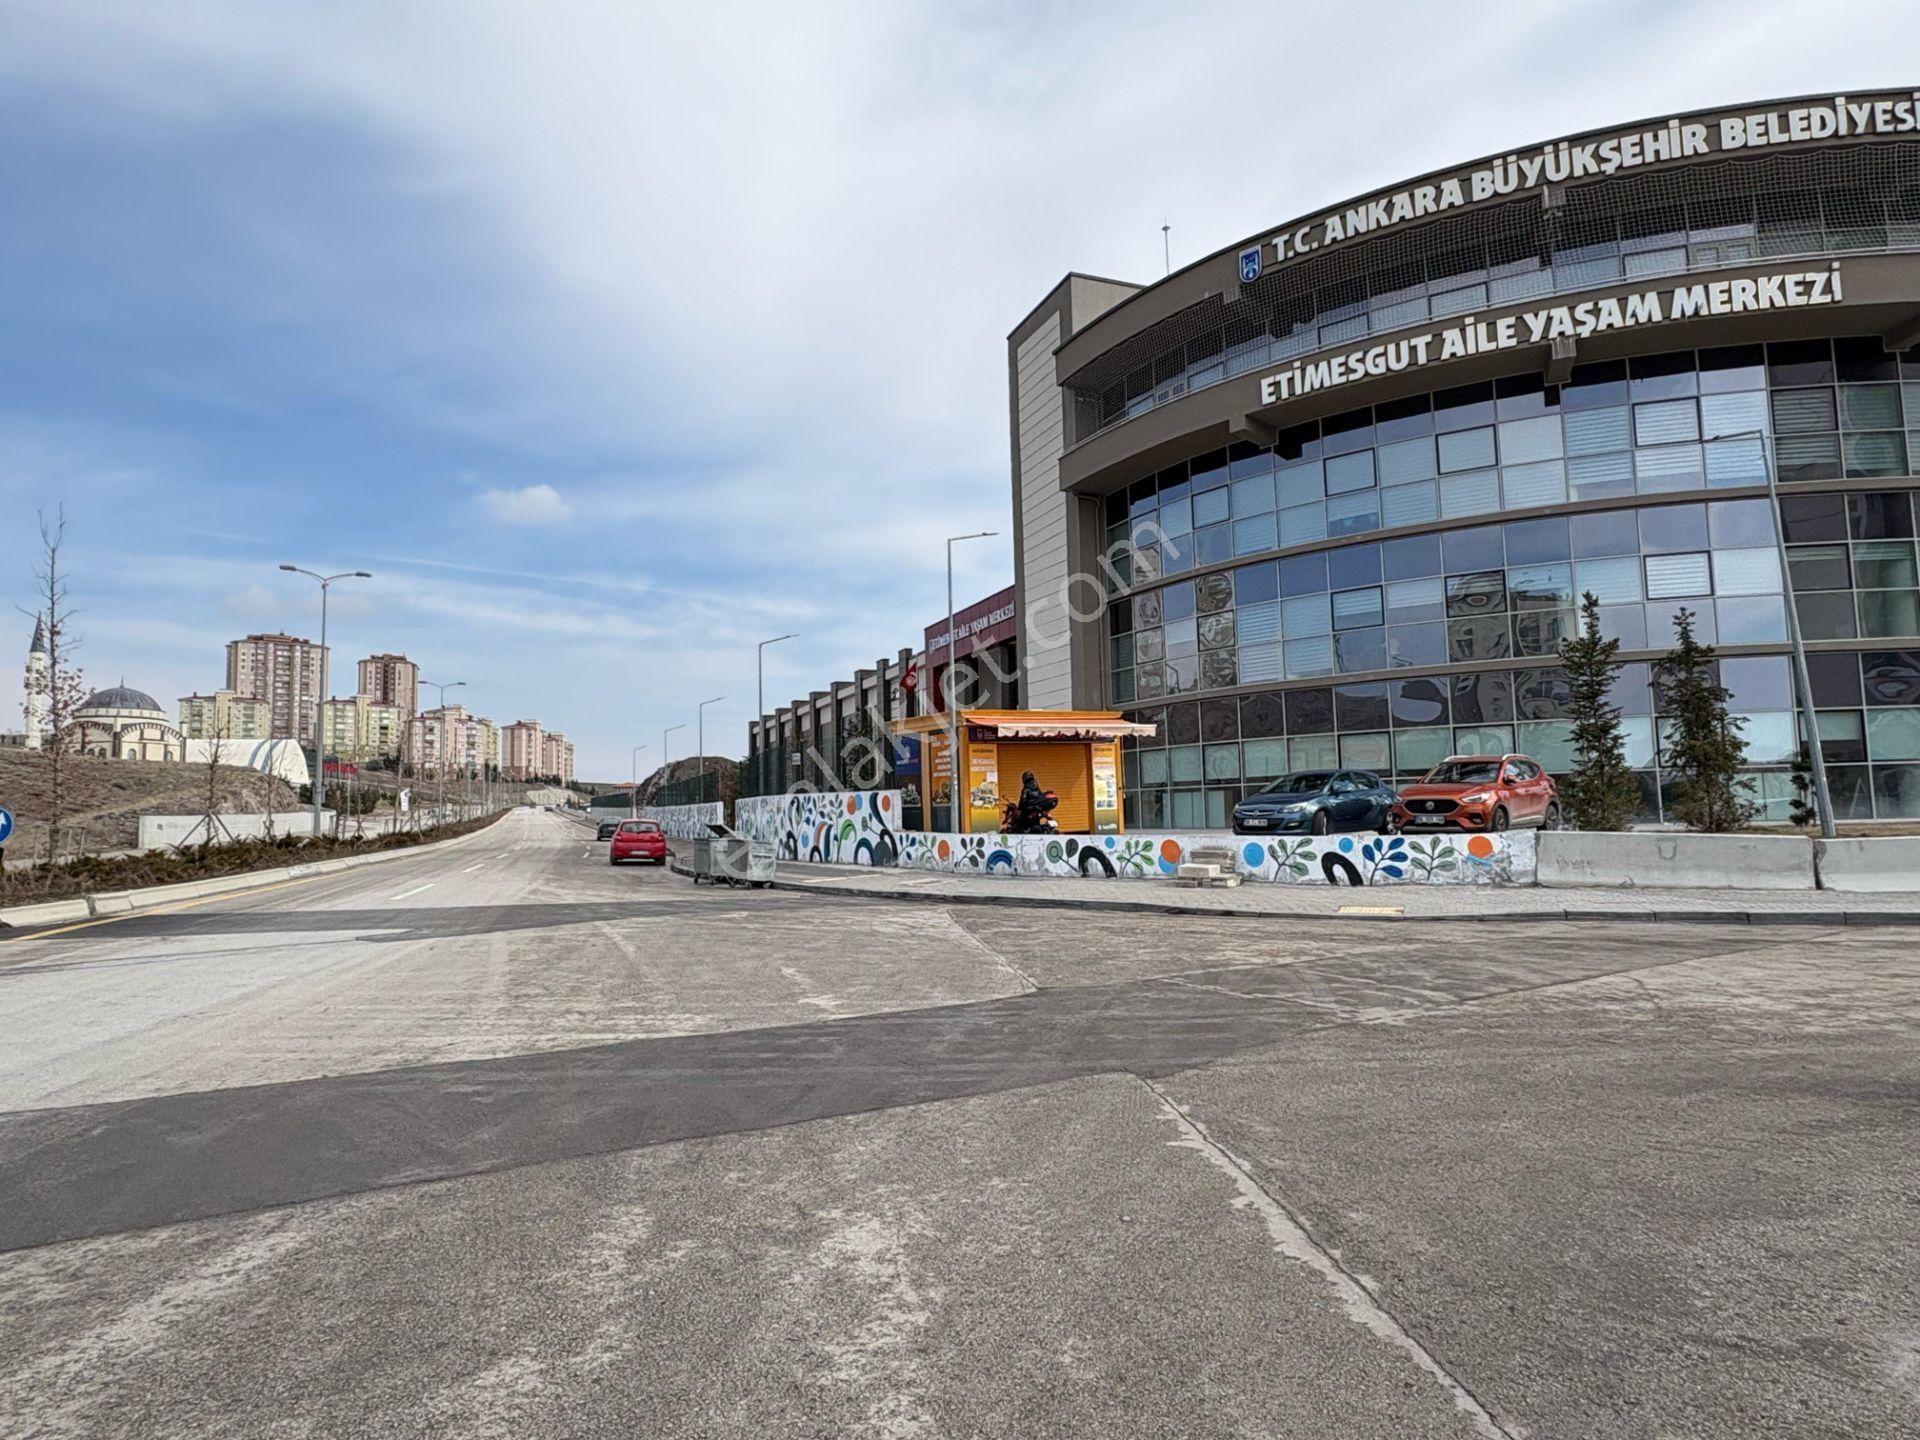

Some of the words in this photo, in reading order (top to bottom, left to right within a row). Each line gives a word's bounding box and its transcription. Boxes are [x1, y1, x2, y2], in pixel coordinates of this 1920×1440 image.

[1271, 225, 1318, 262] T.C.
[1323, 178, 1464, 246] ANKARA
[1471, 119, 1709, 202] BÜYÜKŞEHİR
[1720, 92, 1920, 150] BELEDİYESİ
[1260, 333, 1432, 405] ETİMESGUT
[1440, 316, 1517, 361] AİLE
[1522, 291, 1663, 343] YAŞAM
[1670, 261, 1843, 319] MERKEZİ
